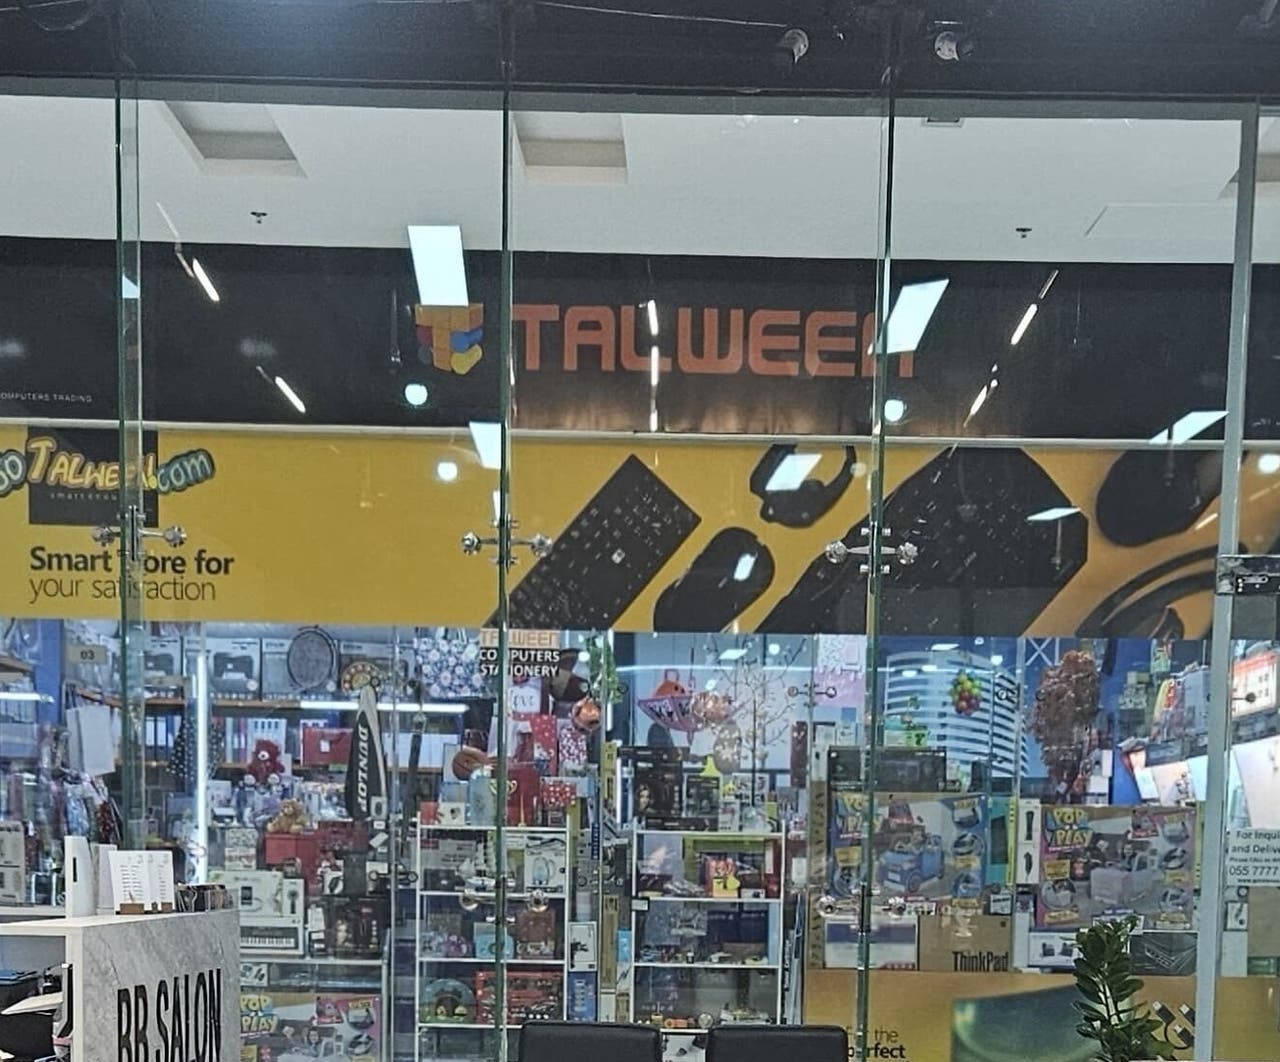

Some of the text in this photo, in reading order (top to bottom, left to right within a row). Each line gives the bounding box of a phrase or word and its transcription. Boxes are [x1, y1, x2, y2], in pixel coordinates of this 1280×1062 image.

[30, 546, 112, 572] Smart
[194, 550, 234, 575] for
[29, 575, 216, 604] your satisaction
[480, 649, 559, 662] COPUTERS
[480, 664, 558, 677] STIONERY
[357, 724, 369, 813] DUNLOP
[1252, 865, 1279, 876] 7777
[953, 950, 1010, 972] ThinkPad
[874, 1026, 899, 1043] the
[847, 1042, 907, 1060] prfect
